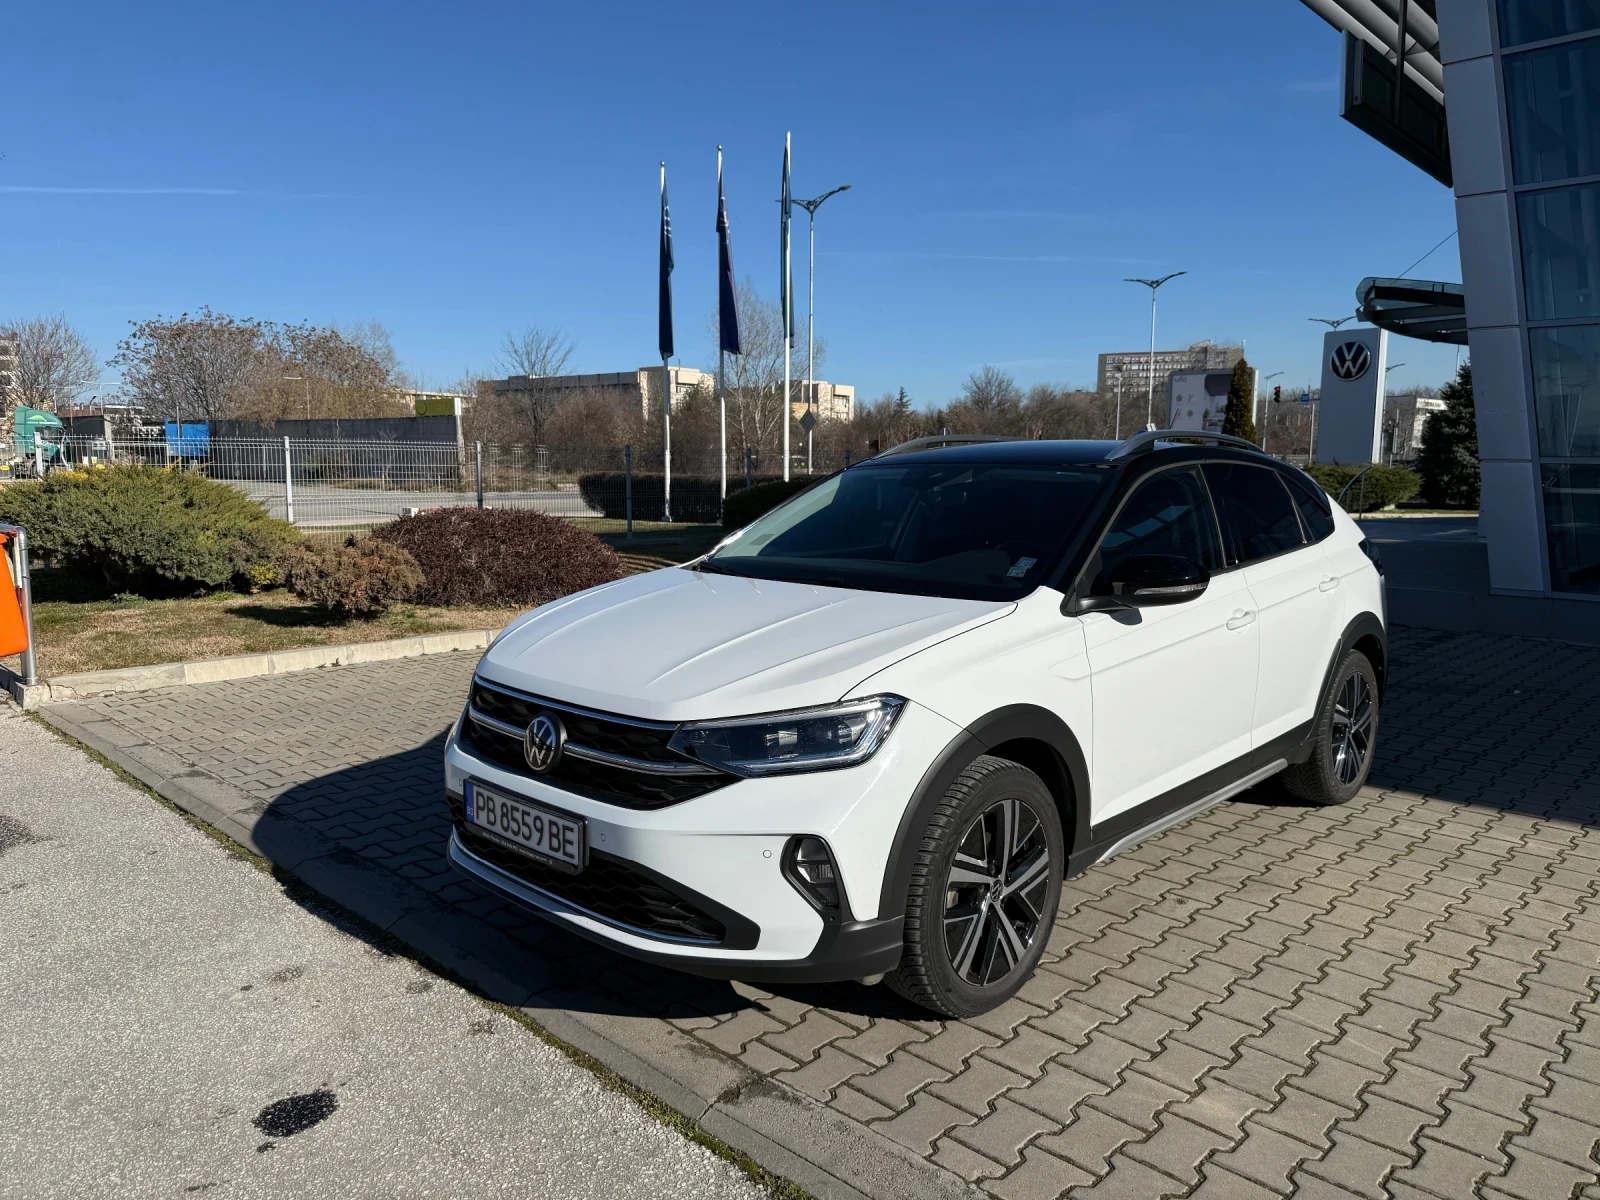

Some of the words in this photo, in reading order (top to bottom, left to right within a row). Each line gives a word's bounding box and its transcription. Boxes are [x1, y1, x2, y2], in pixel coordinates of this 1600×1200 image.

[1330, 341, 1370, 380] VW
[525, 717, 556, 769] VW
[475, 790, 497, 827] PB
[500, 801, 544, 847] 8559
[548, 819, 575, 860] BE
